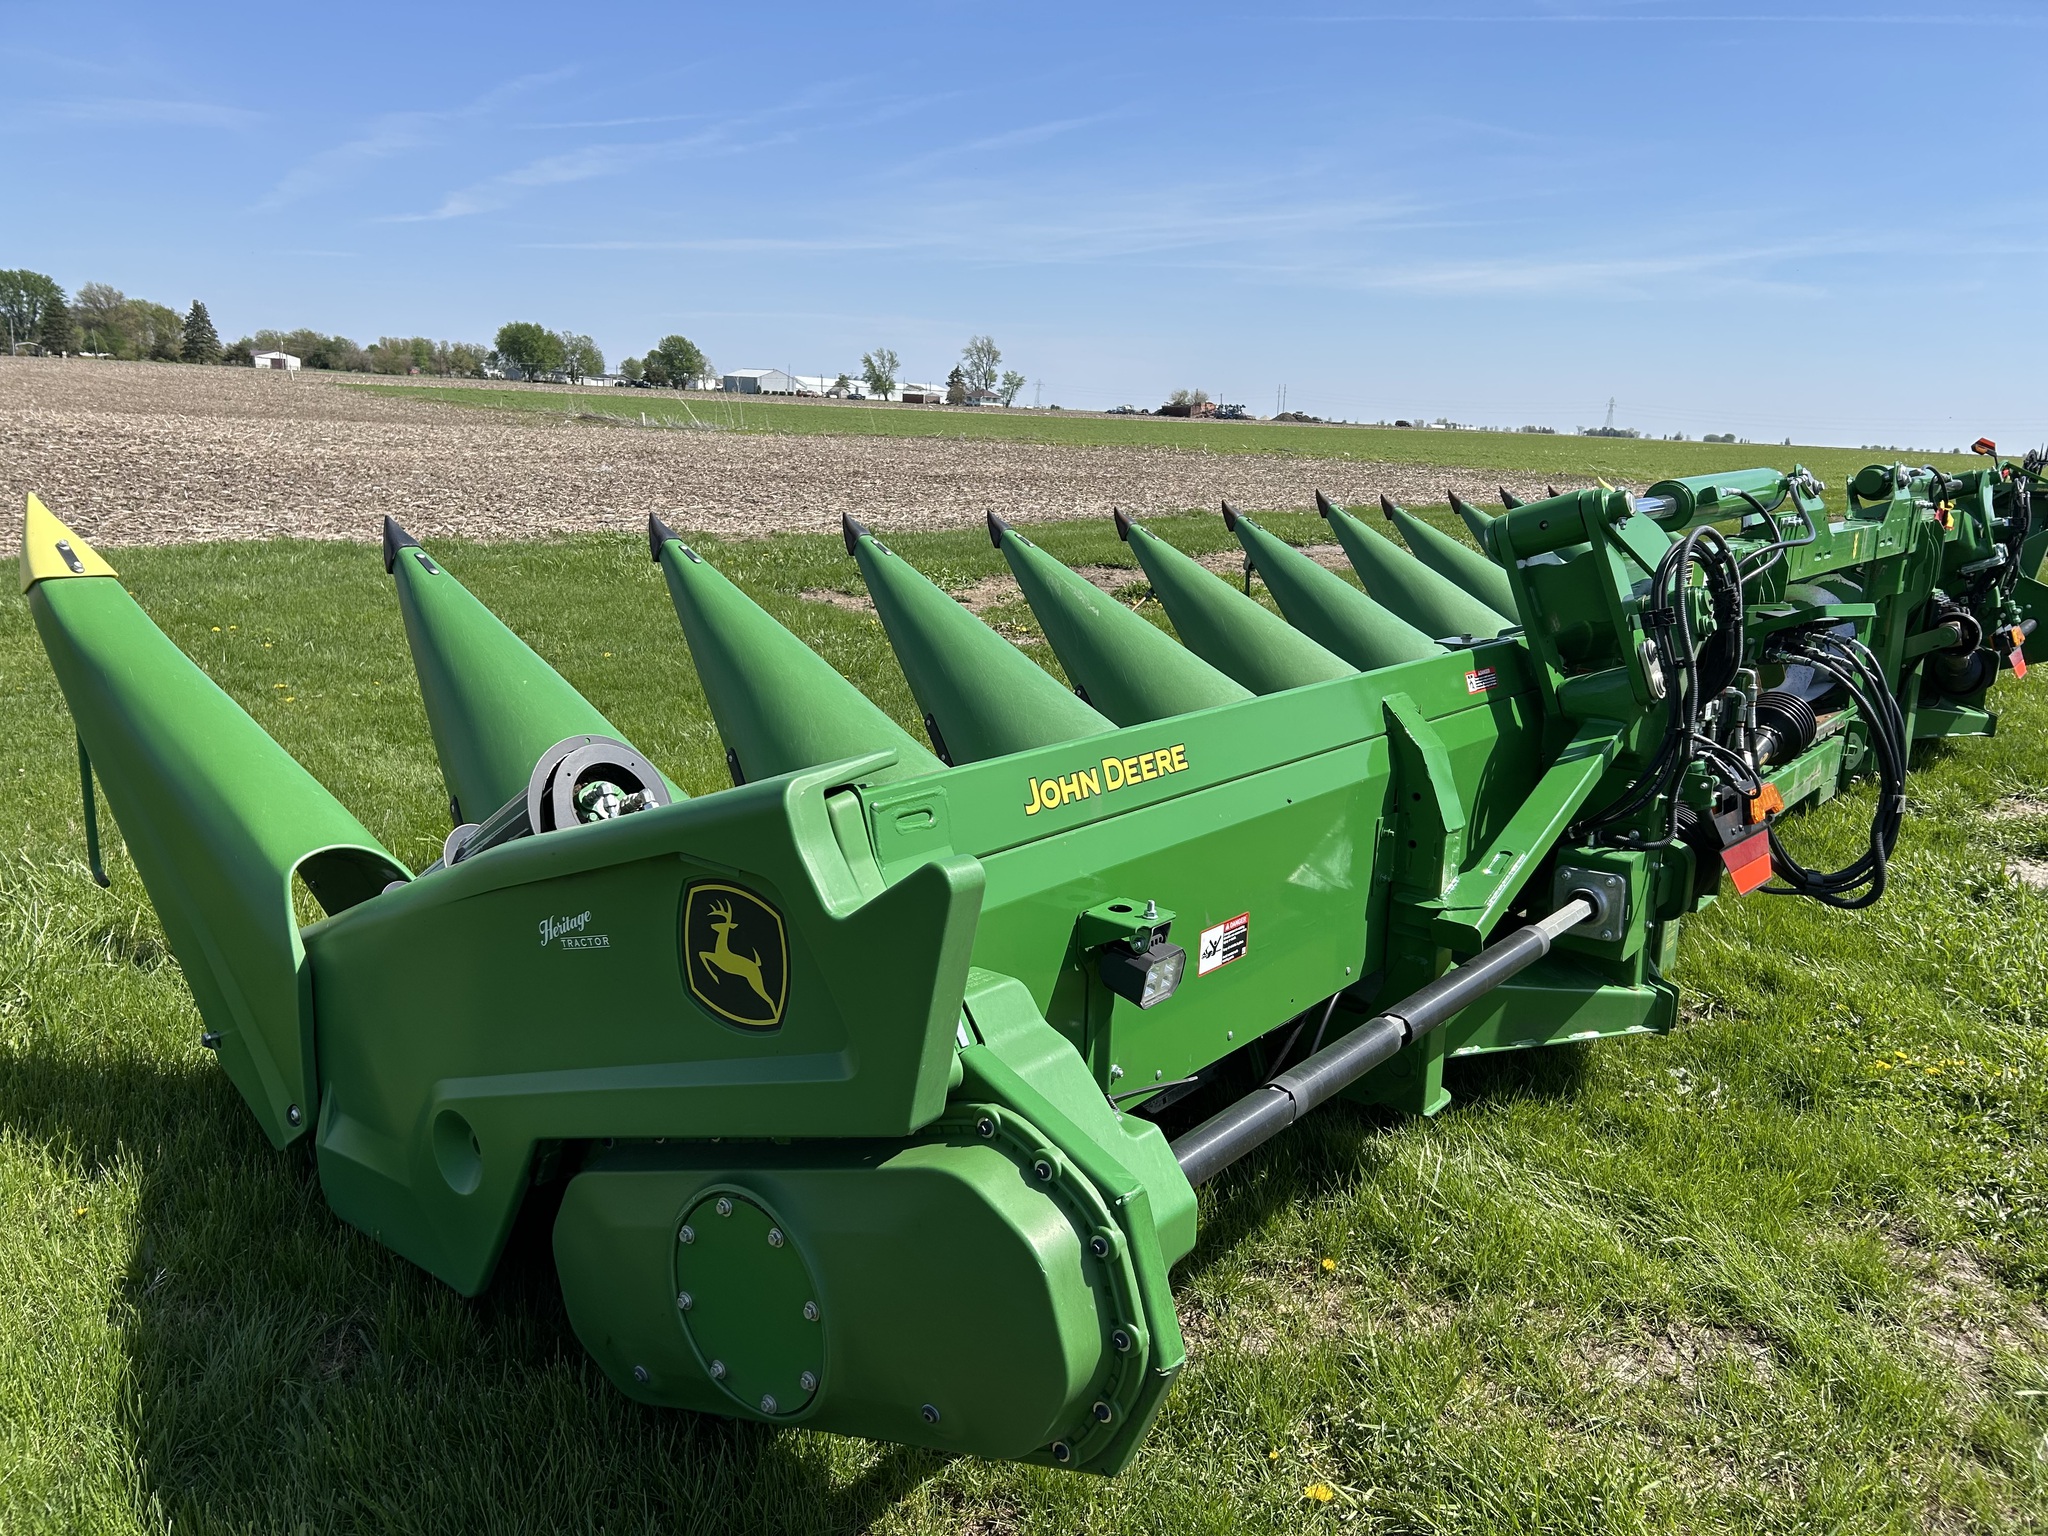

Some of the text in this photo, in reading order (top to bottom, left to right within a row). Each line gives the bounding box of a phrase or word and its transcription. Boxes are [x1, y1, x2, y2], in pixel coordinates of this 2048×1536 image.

[1024, 743, 1189, 816] JOHN DEERE
[538, 910, 592, 947] Heritage
[1229, 915, 1247, 929] DANGER
[561, 936, 610, 948] TRACTOR
